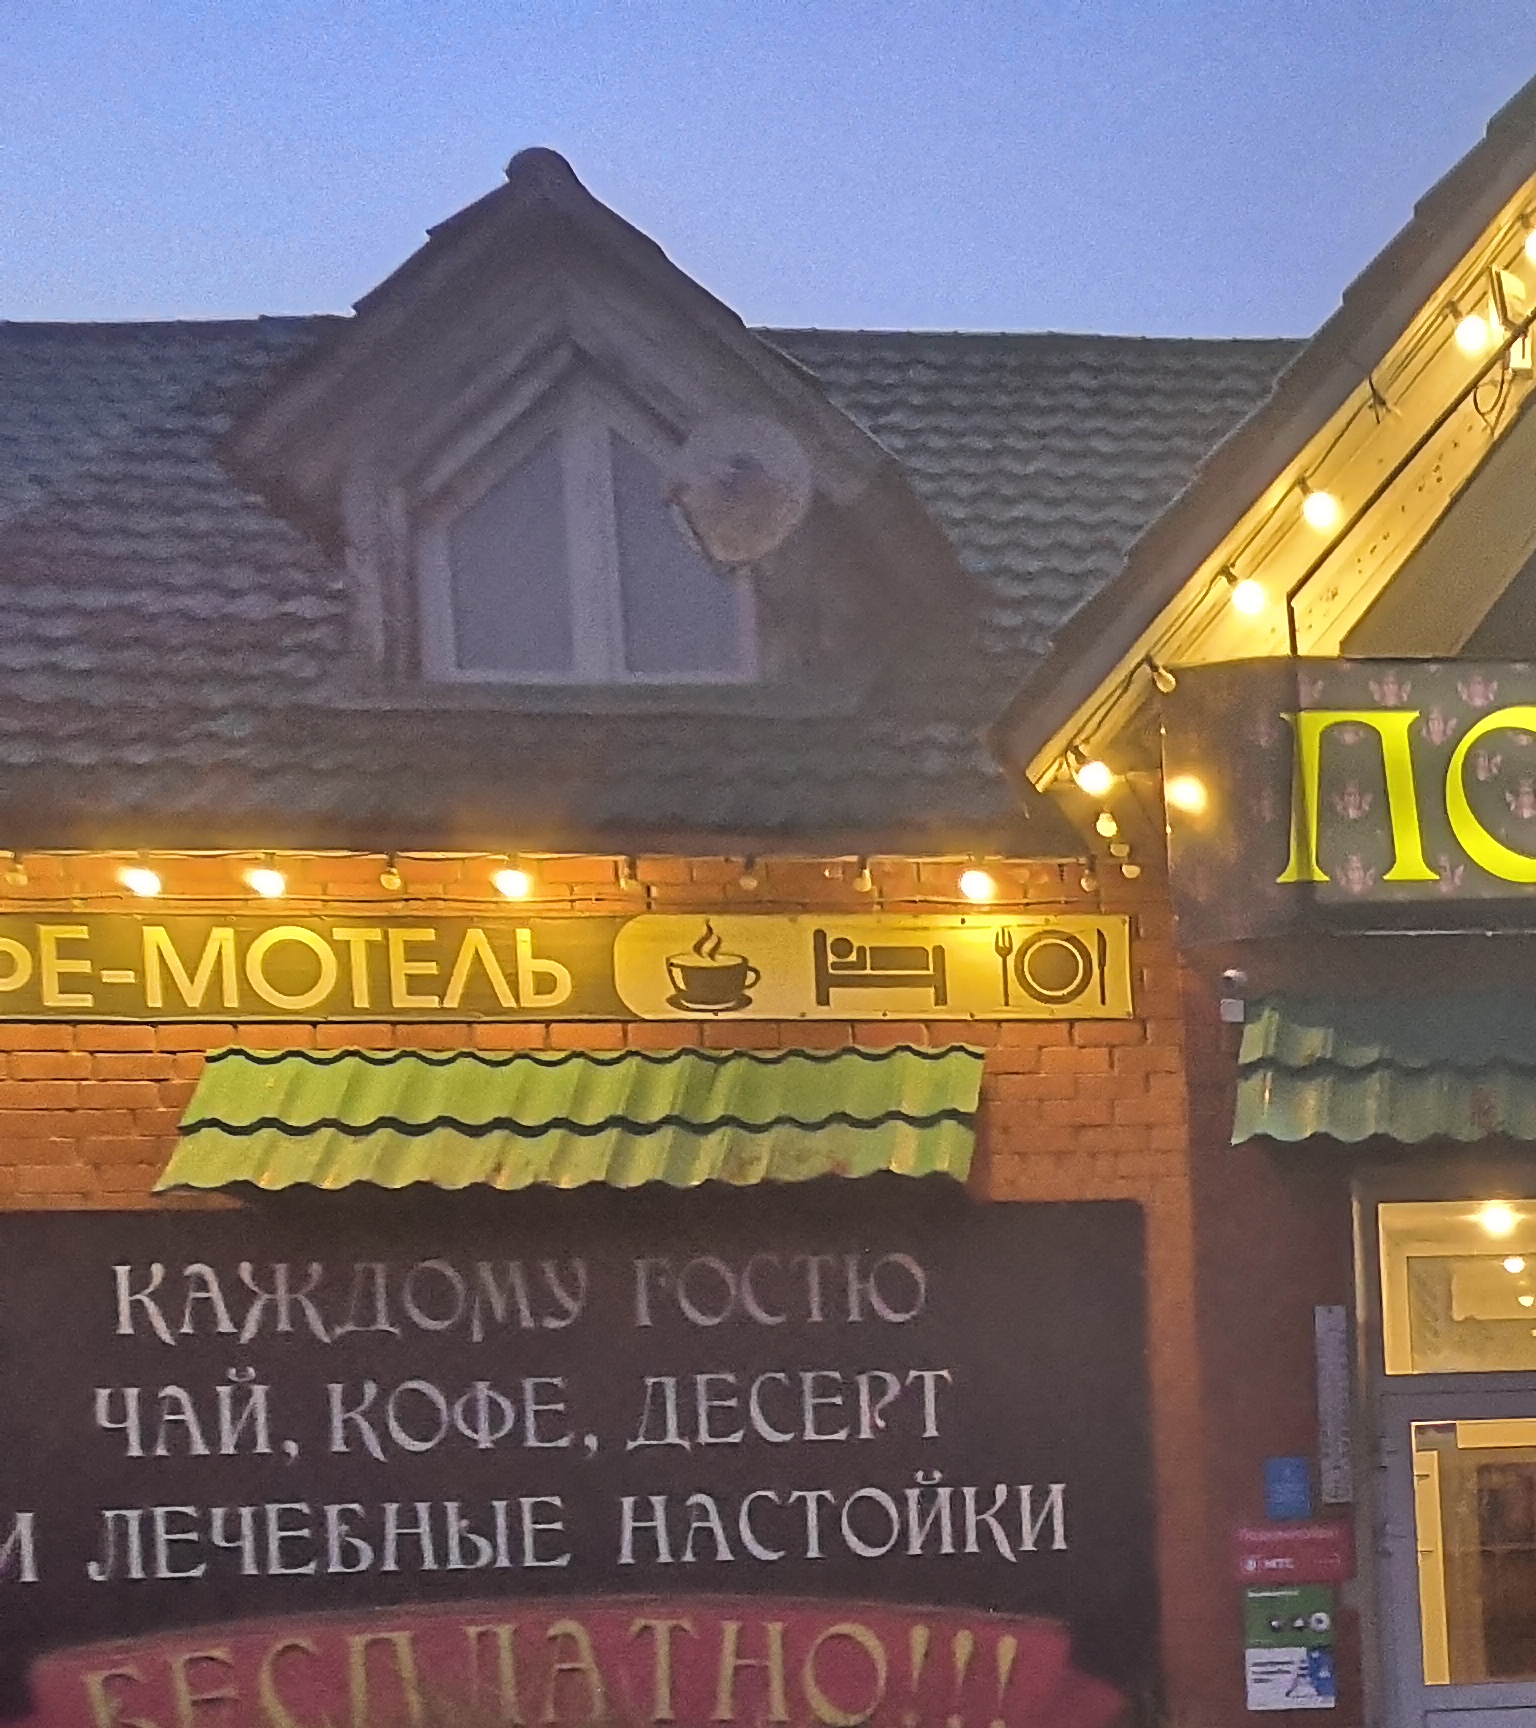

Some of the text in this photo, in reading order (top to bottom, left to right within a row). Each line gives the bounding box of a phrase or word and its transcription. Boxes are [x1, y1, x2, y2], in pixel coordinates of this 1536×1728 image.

[112, 1251, 927, 1345] КАЖДОМУ ГОСТЮ
[95, 1366, 954, 1464] ЧАЙ, КОФЕ, ДЕСЕРТ
[86, 1495, 571, 1582] ЛЕЧЕБНЫЕ
[617, 1470, 1068, 1564] НАСТОЙКИ
